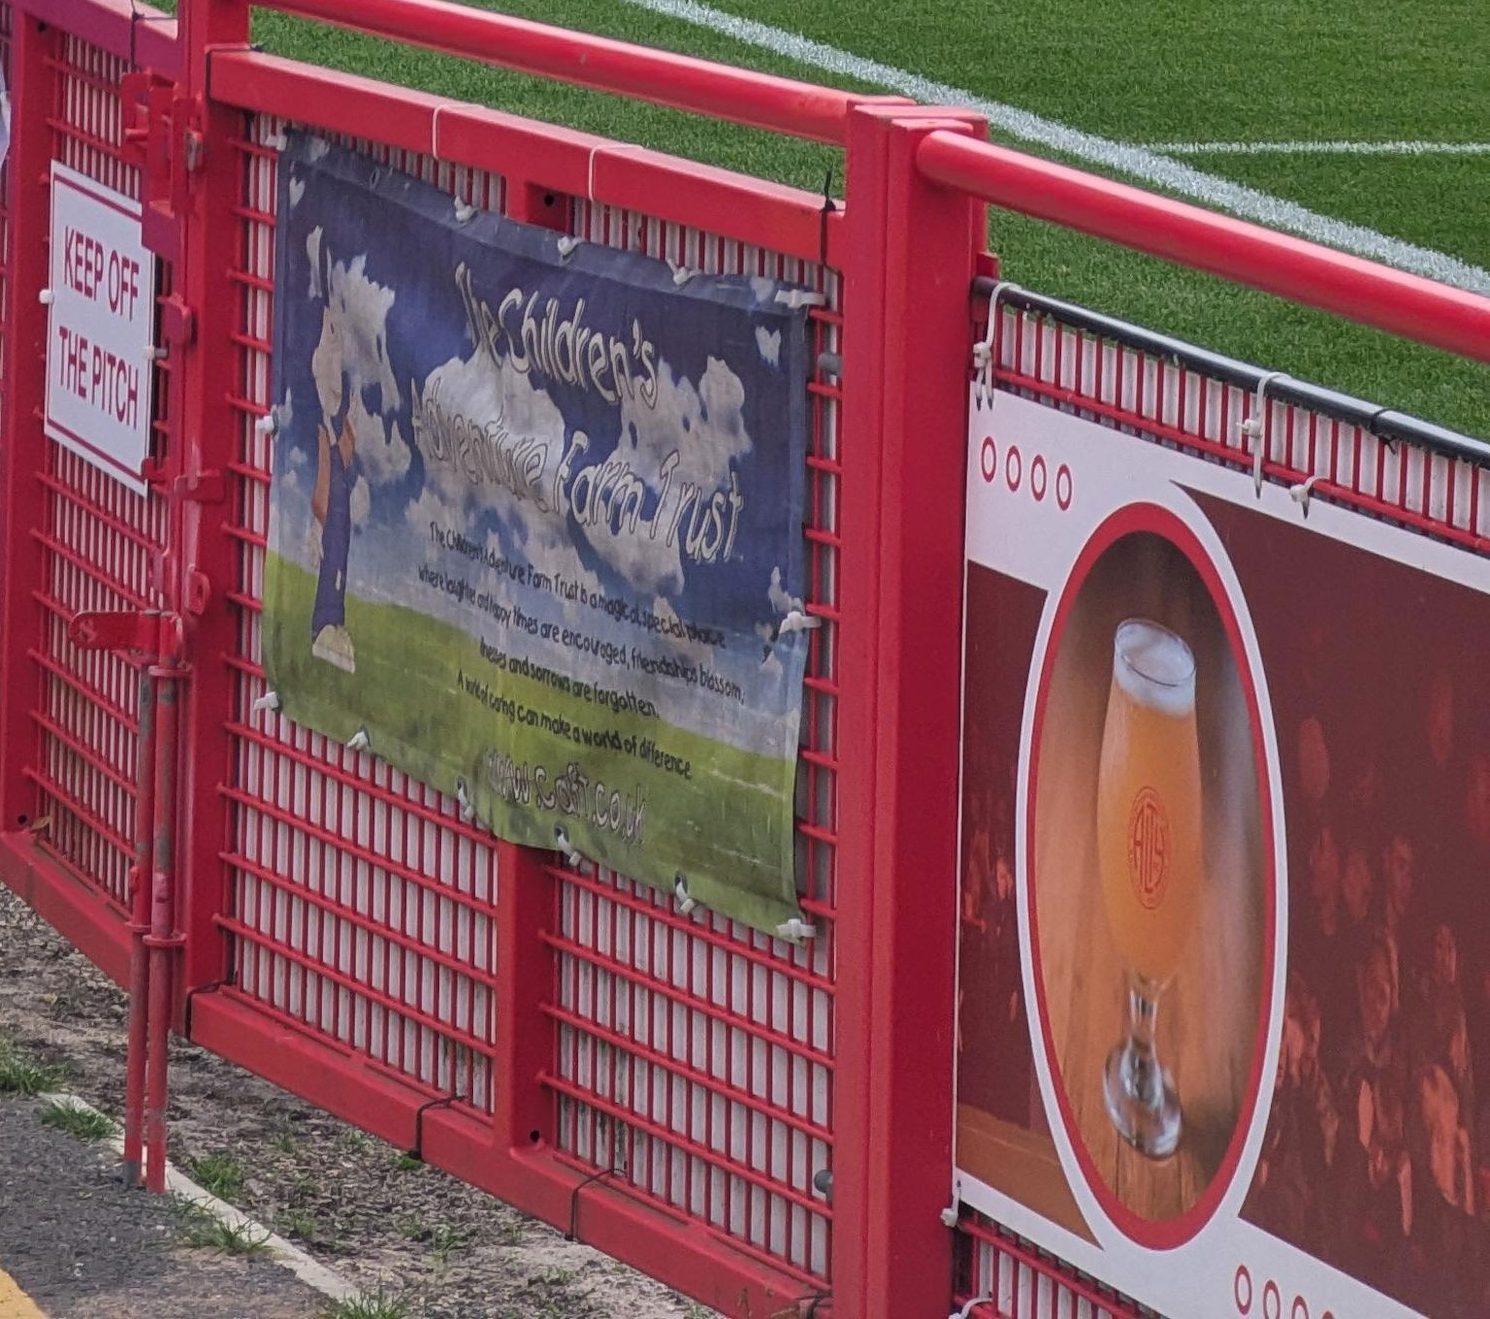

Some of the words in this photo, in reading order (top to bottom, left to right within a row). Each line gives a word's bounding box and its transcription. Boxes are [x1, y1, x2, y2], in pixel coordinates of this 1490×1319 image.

[64, 226, 104, 302] KEEP
[108, 248, 140, 323] OFF
[58, 324, 88, 400] THE
[91, 345, 140, 431] PITCH
[499, 288, 657, 410] Children's
[554, 431, 646, 535] Farm
[650, 449, 744, 562] Trust
[528, 563, 553, 593] Farm
[554, 573, 579, 600] Trust
[513, 606, 539, 636] times
[541, 622, 559, 643] are
[509, 656, 529, 677] and
[572, 680, 592, 703] are
[517, 705, 539, 728] can
[541, 714, 571, 740] make
[573, 727, 580, 745] a
[581, 728, 622, 751] world
[623, 735, 637, 757] of
